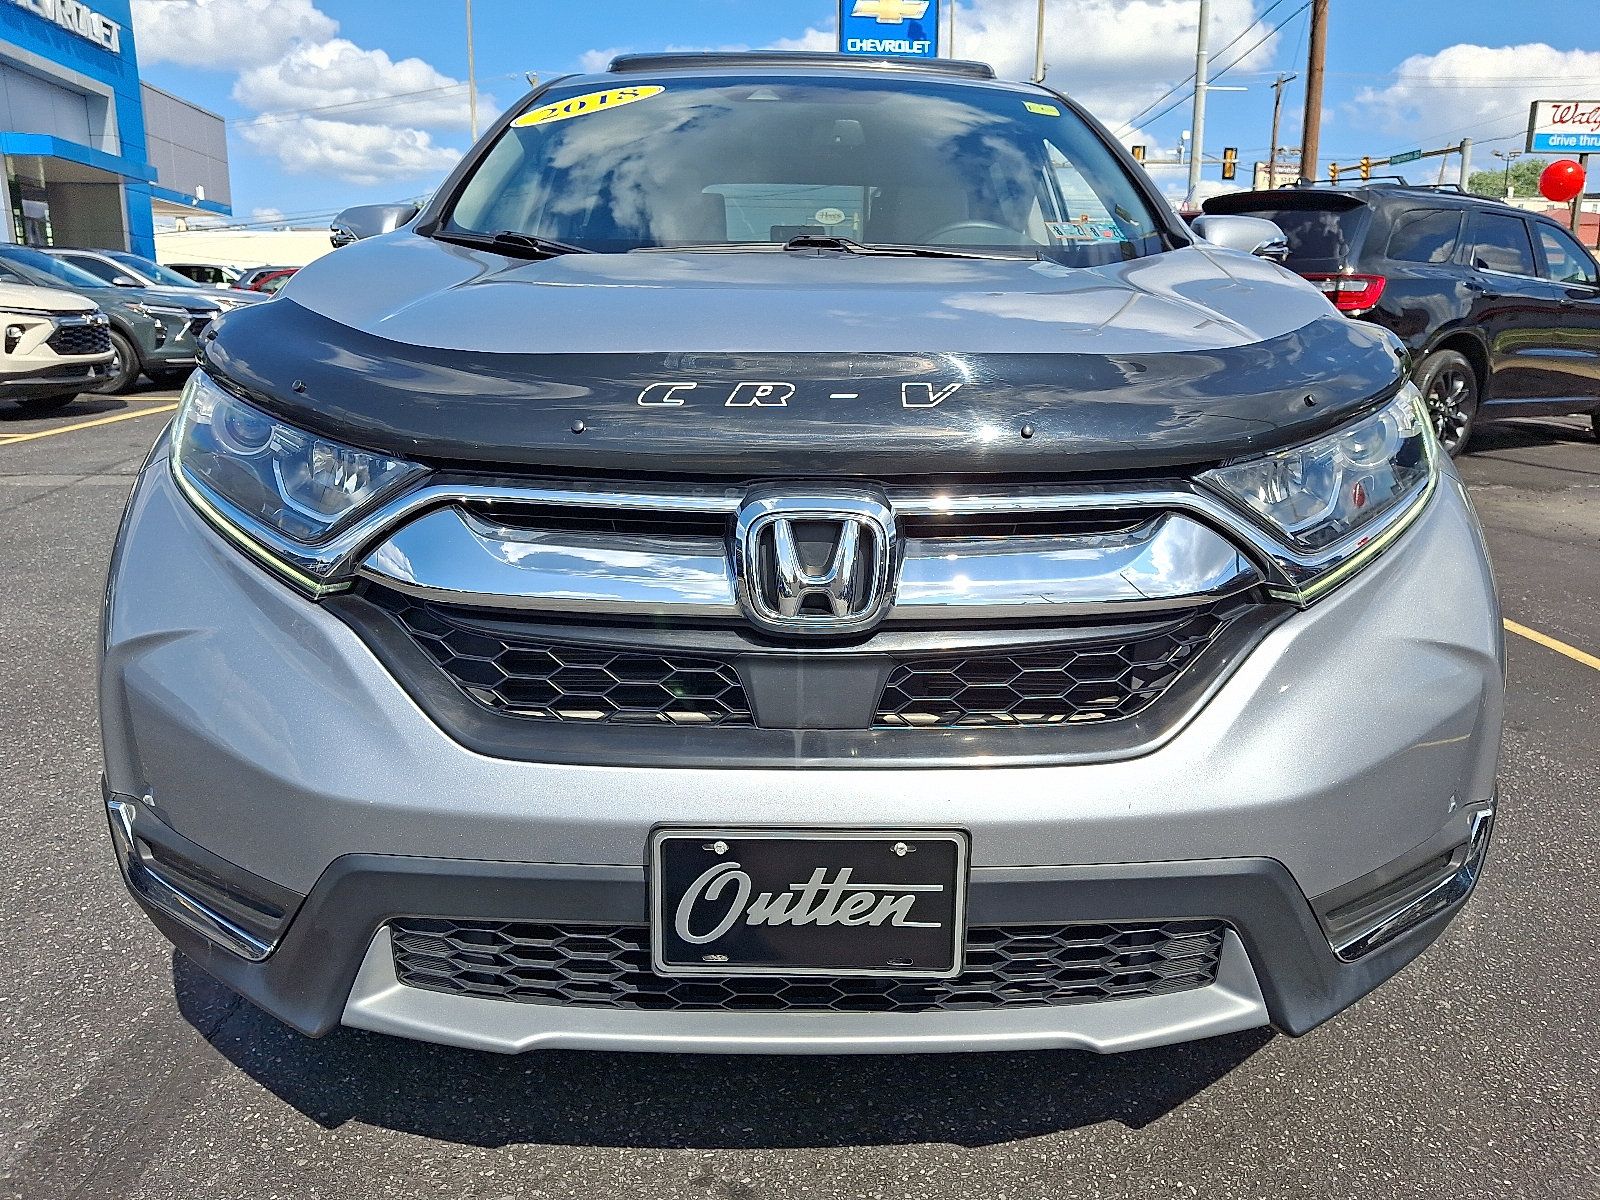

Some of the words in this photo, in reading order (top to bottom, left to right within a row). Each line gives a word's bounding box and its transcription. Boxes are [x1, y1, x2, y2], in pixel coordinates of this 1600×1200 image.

[847, 38, 931, 53] CHEVROLET
[539, 88, 641, 121] 2018
[1548, 134, 1577, 146] drive
[1580, 134, 1600, 146] thru
[675, 861, 944, 944] Outten
